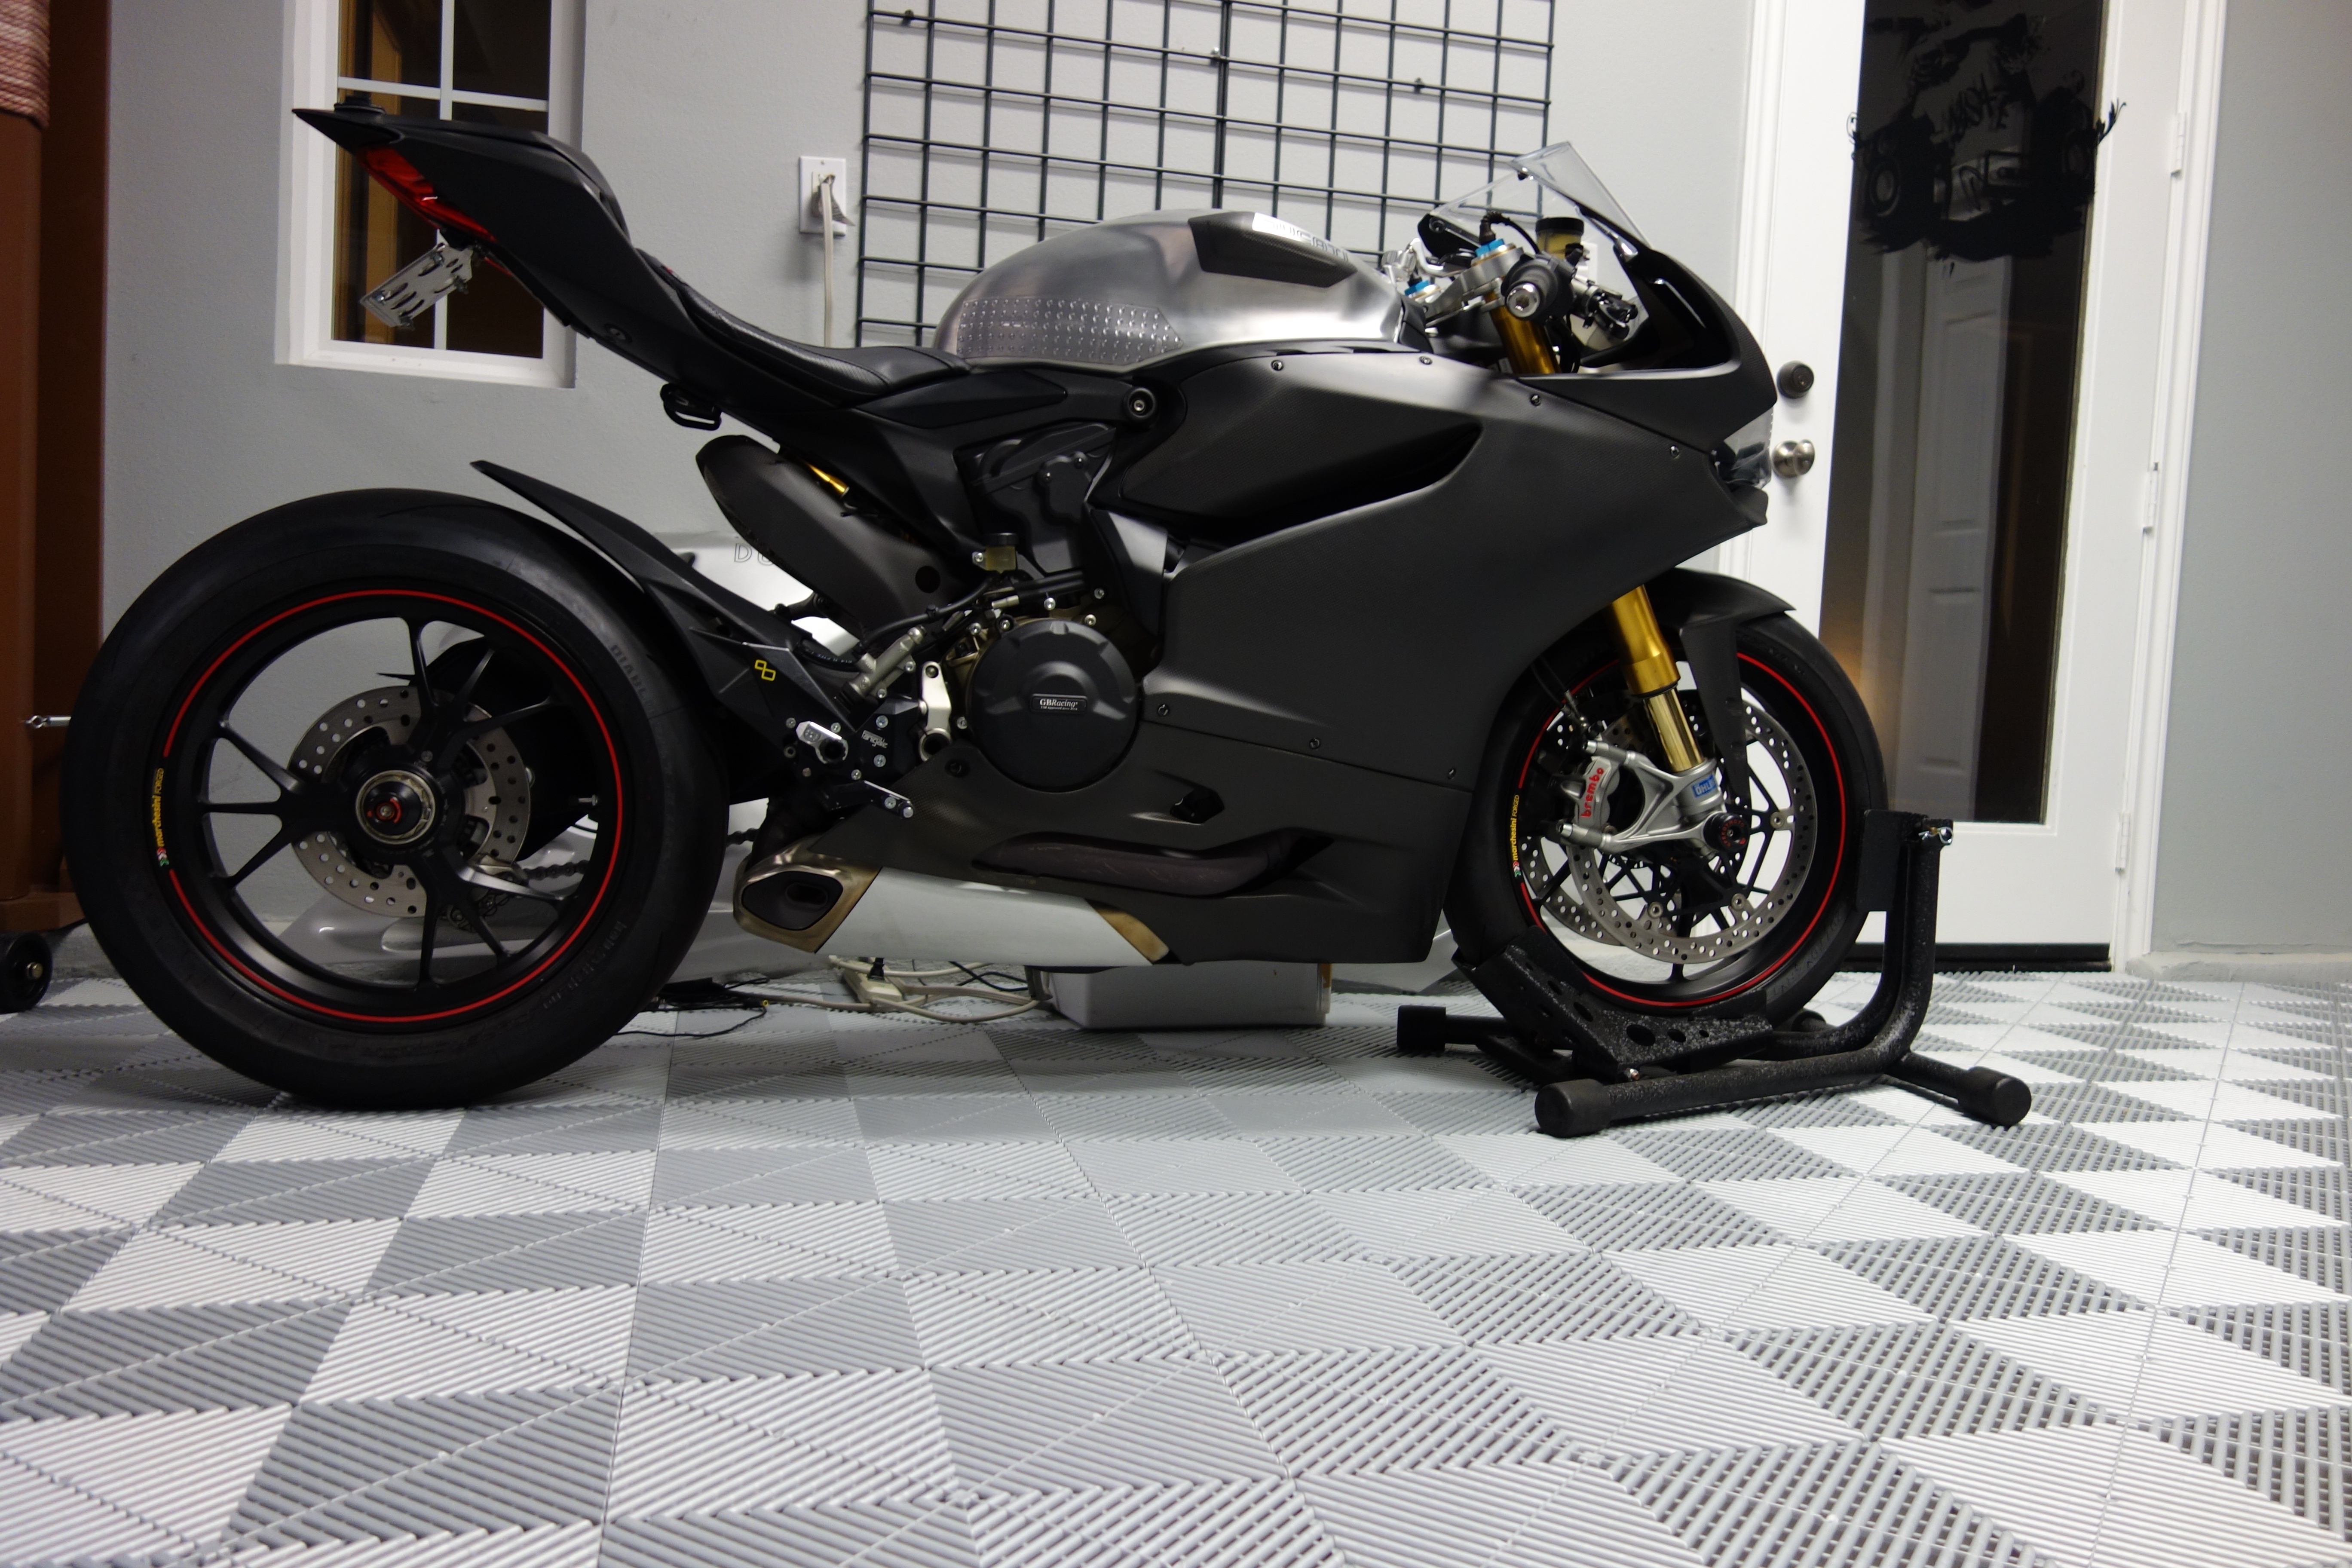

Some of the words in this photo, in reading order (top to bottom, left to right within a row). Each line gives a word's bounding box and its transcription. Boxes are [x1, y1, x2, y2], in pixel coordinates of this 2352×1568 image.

[1580, 767, 1604, 818] brembo
[152, 795, 165, 847] marchesini
[1510, 818, 1519, 861] marchesini
